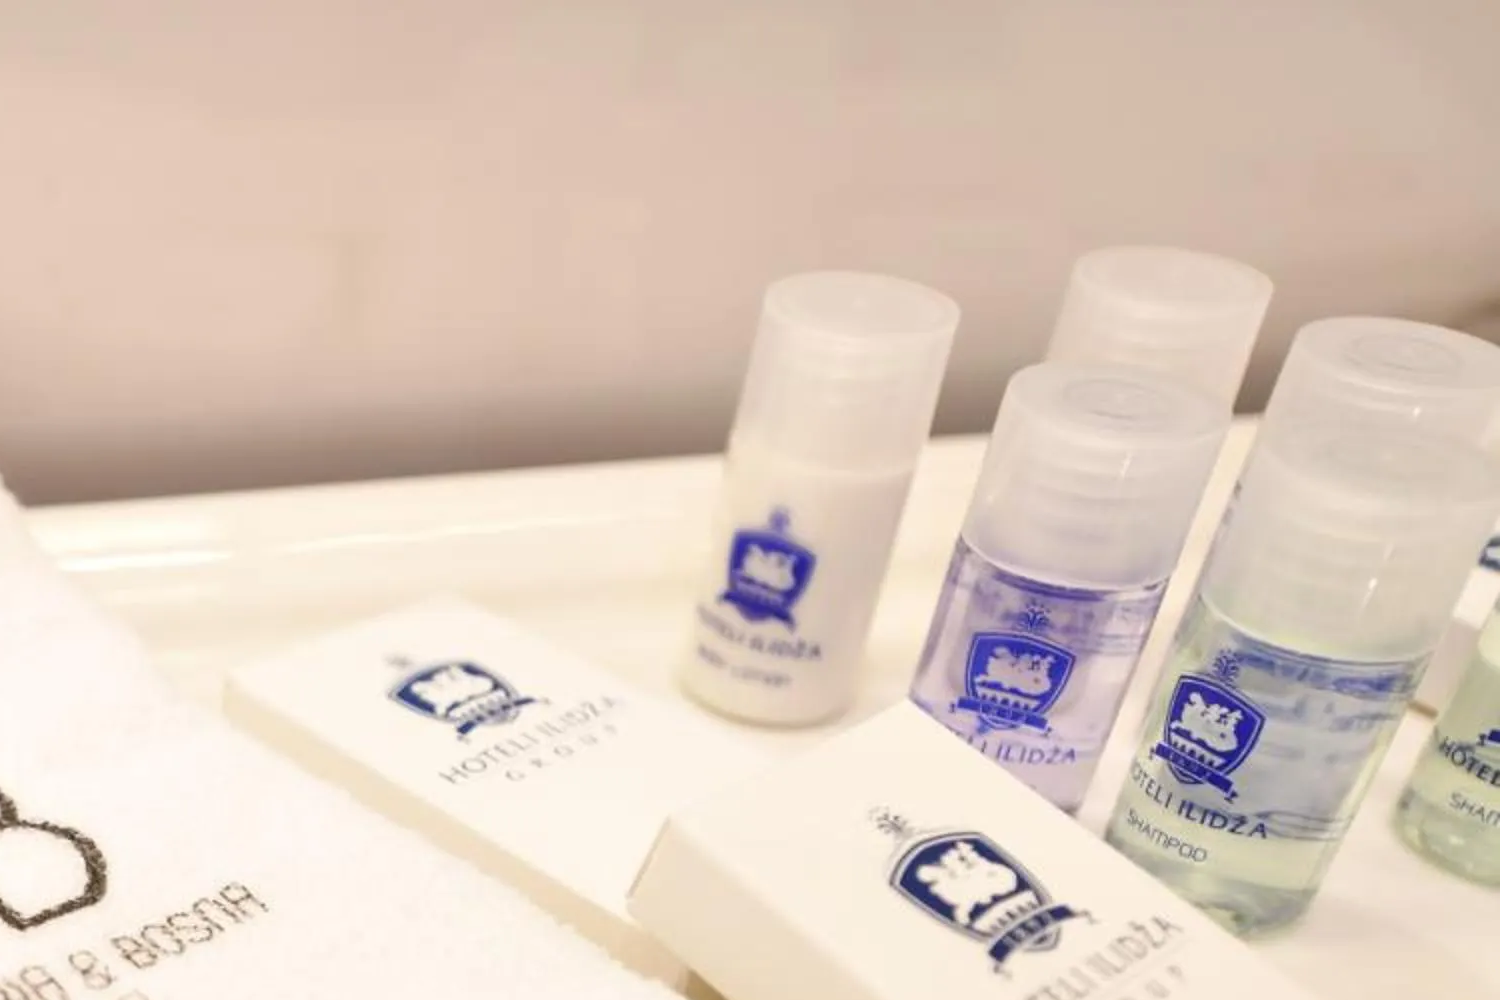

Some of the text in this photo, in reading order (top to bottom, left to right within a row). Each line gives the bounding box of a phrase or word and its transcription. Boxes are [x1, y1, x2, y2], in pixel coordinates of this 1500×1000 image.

[1439, 735, 1500, 788] HOTEL
[1131, 760, 1268, 840] OTELI ILIDŽA
[1449, 791, 1500, 827] SHAM
[1126, 807, 1209, 863] SHAMPOO
[67, 949, 118, 991] &
[110, 882, 269, 969] BOSNA
